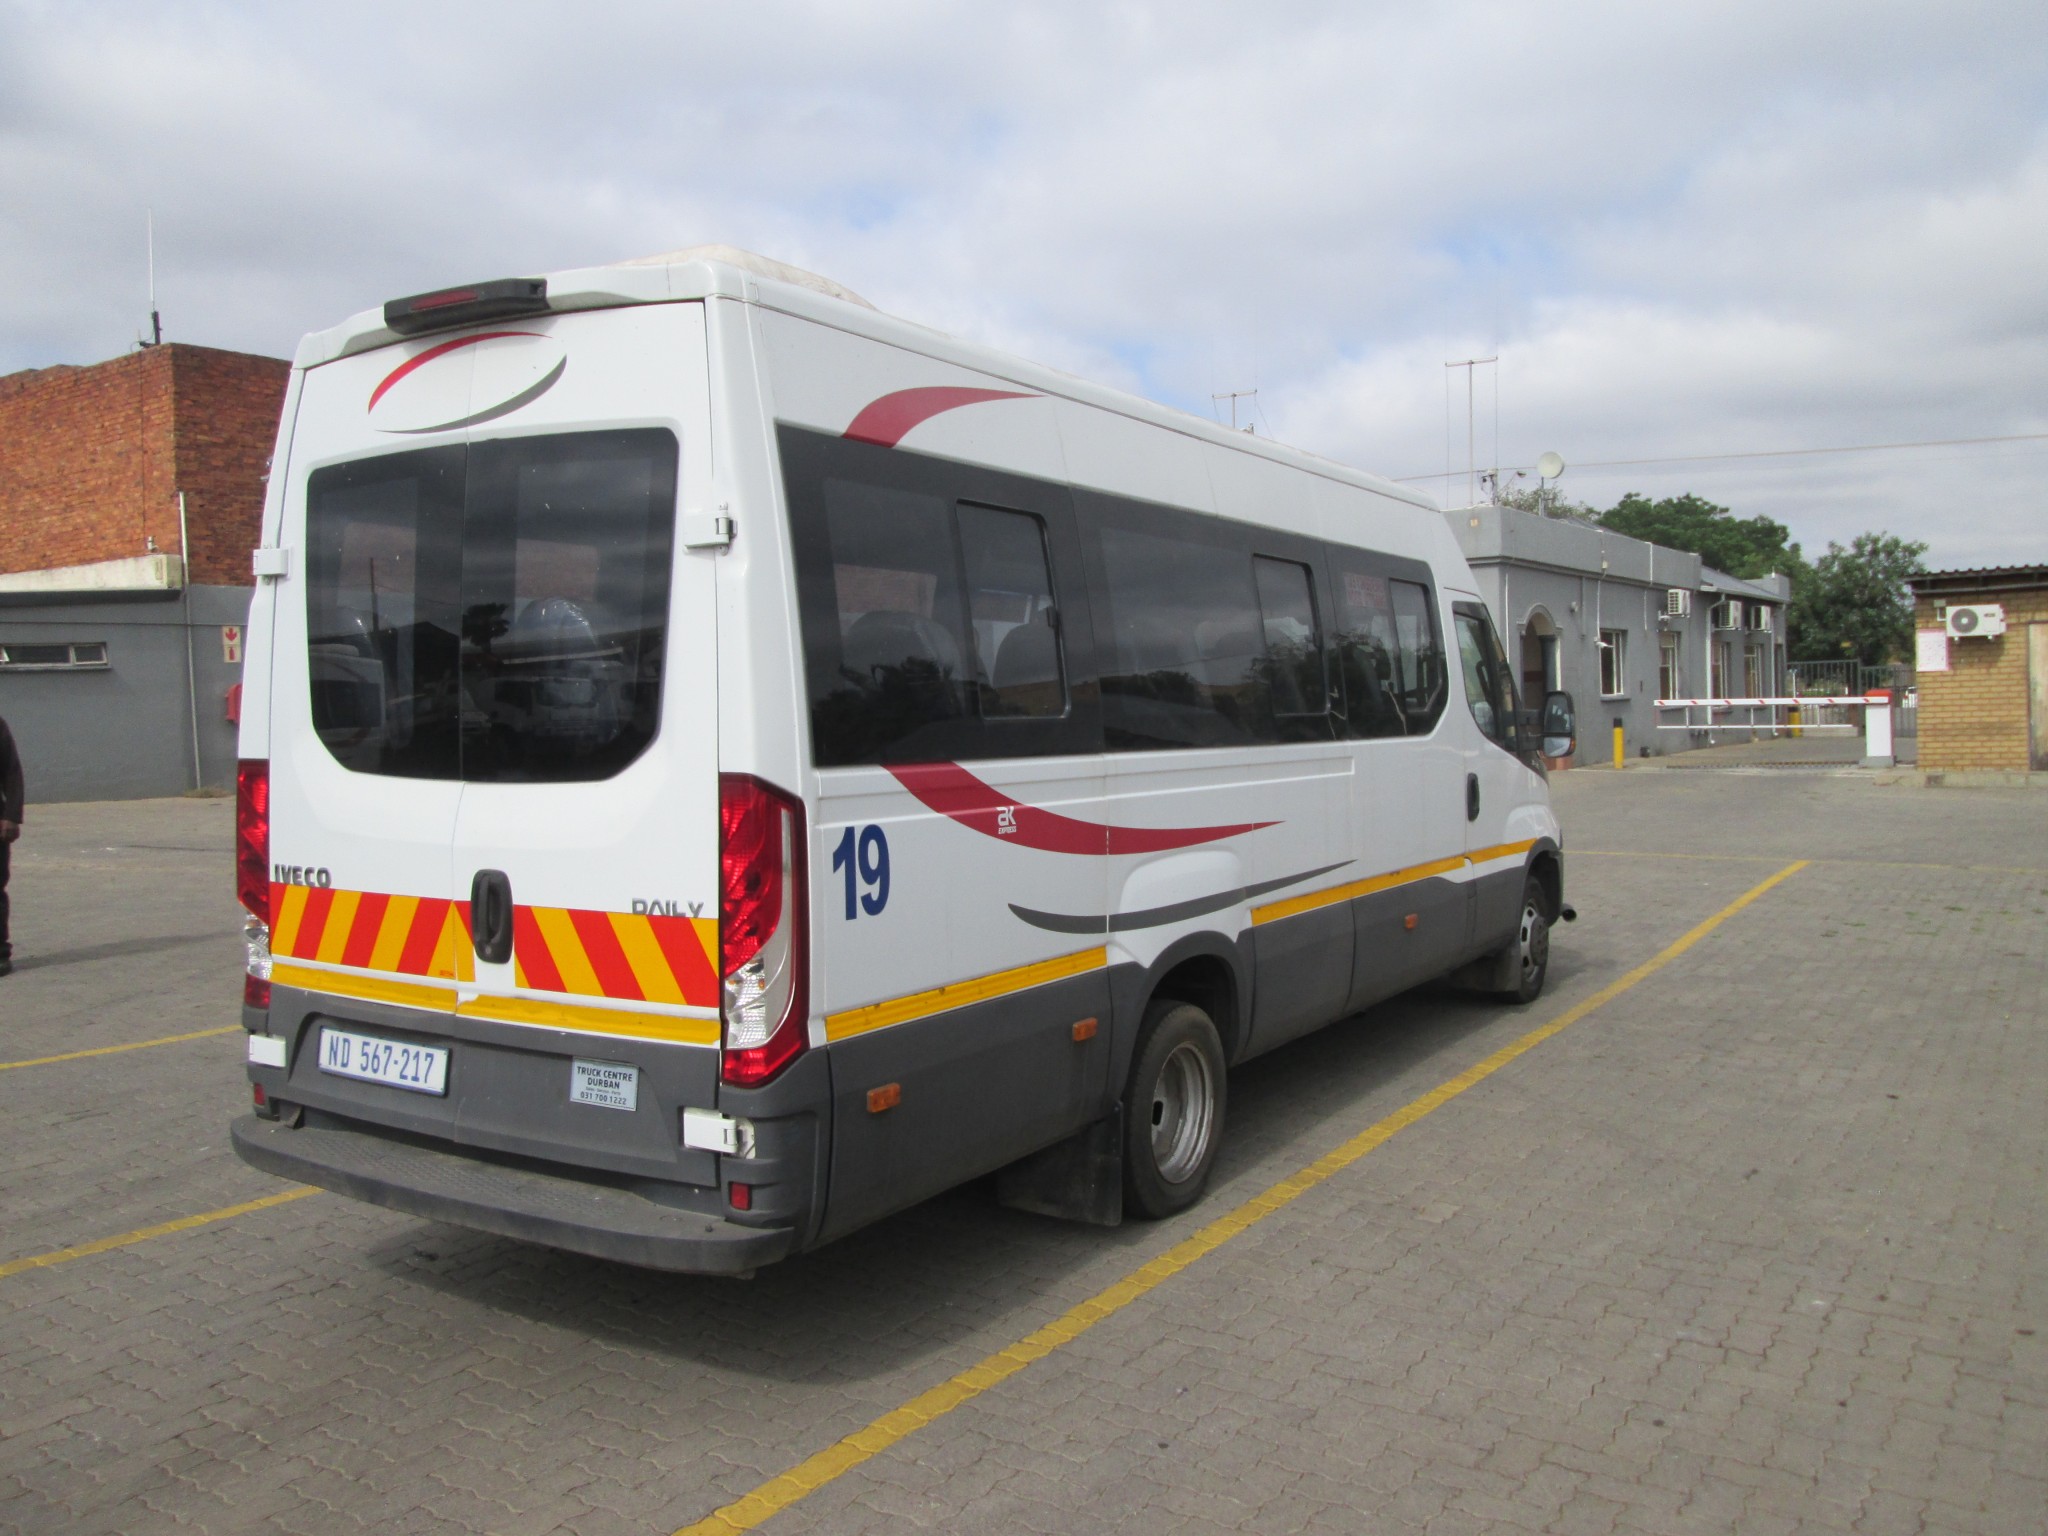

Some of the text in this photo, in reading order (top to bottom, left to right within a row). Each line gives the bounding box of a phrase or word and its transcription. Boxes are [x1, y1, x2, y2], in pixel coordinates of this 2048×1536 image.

[274, 864, 332, 888] IVECO
[833, 824, 890, 920] 19
[632, 898, 704, 918] DAILY
[328, 1035, 434, 1083] ND 567-217
[577, 1066, 633, 1082] TRUCK CENTRE
[587, 1077, 620, 1089] DURBAN
[580, 1091, 627, 1105] 031 700 1222
